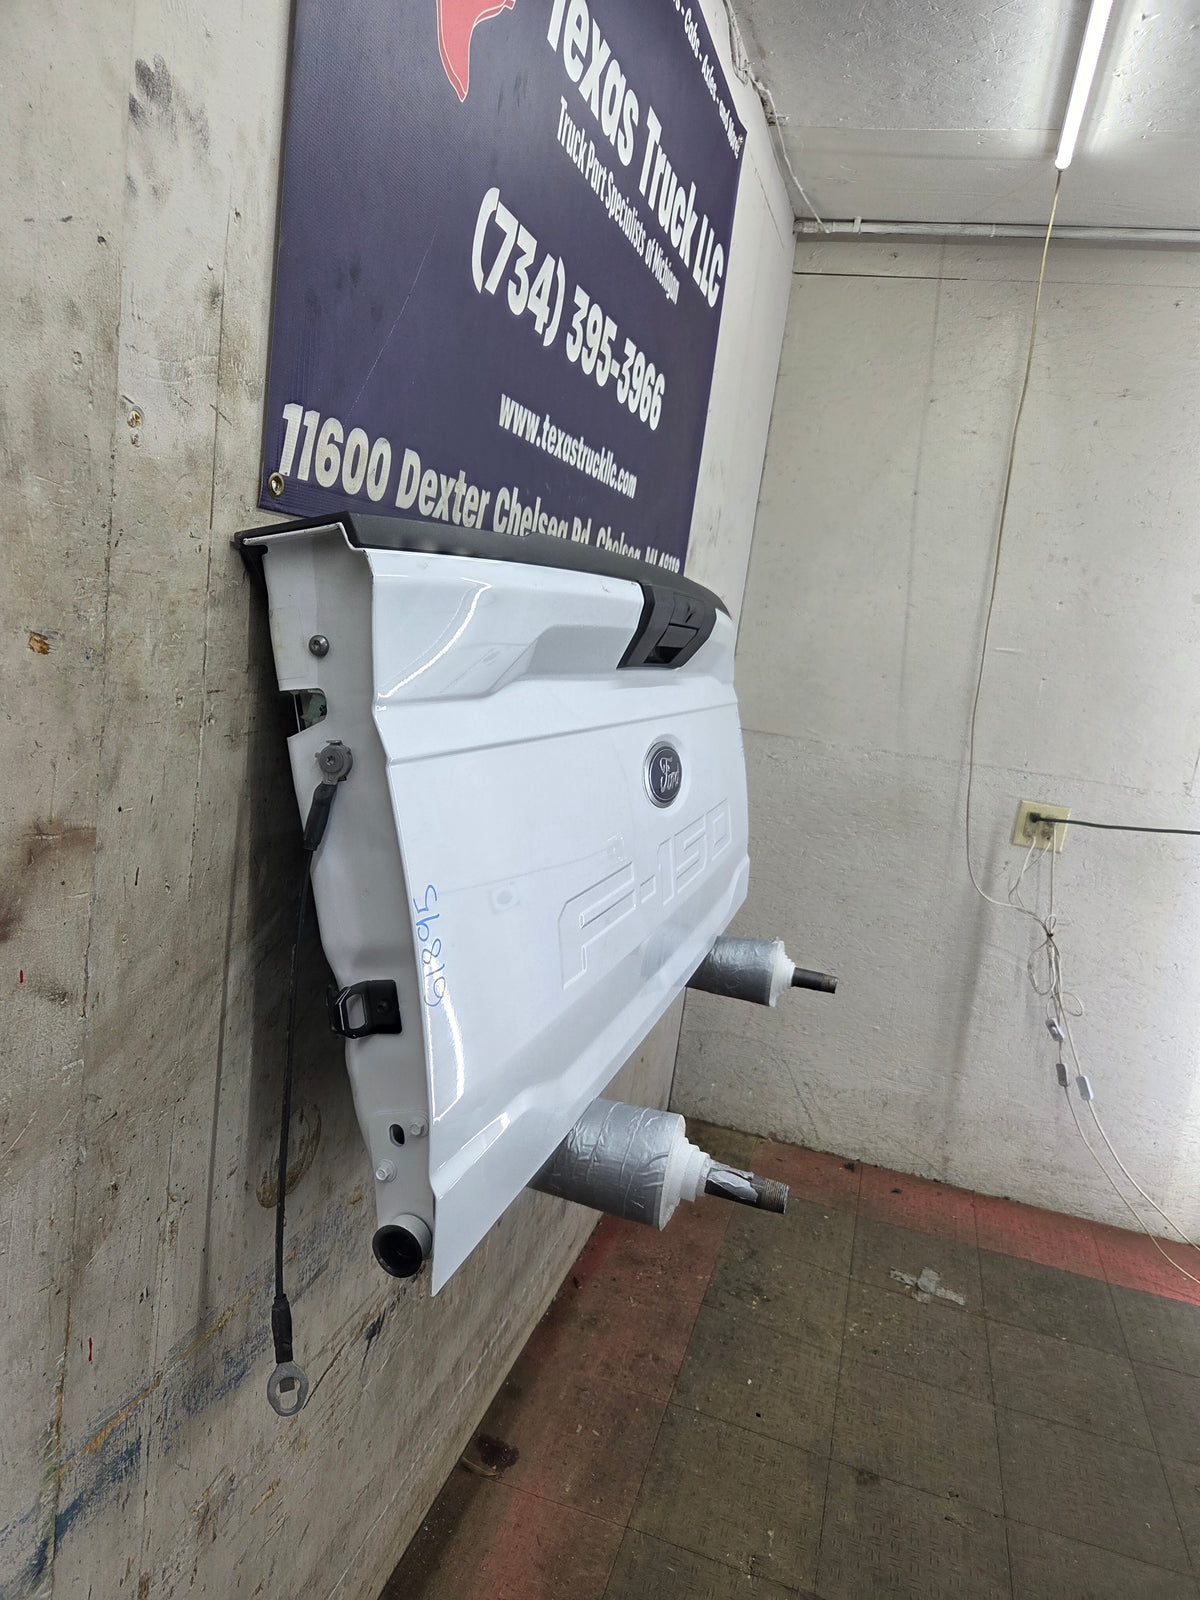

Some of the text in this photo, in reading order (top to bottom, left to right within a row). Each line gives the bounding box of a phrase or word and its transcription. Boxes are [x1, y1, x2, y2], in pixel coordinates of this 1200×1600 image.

[685, 8, 700, 58] Cabs
[702, 54, 717, 101] Axles
[557, 95, 680, 305] Truck Part Specialists of Michigan
[639, 105, 698, 269] Truck
[693, 214, 724, 308] LLC
[471, 187, 665, 431] (734) 395-3966
[278, 403, 392, 502] 11600
[395, 448, 491, 530] Dexter
[499, 393, 637, 499] www.texastruckllc.com
[413, 885, 446, 1007] 61895
[558, 798, 732, 990] F-150
